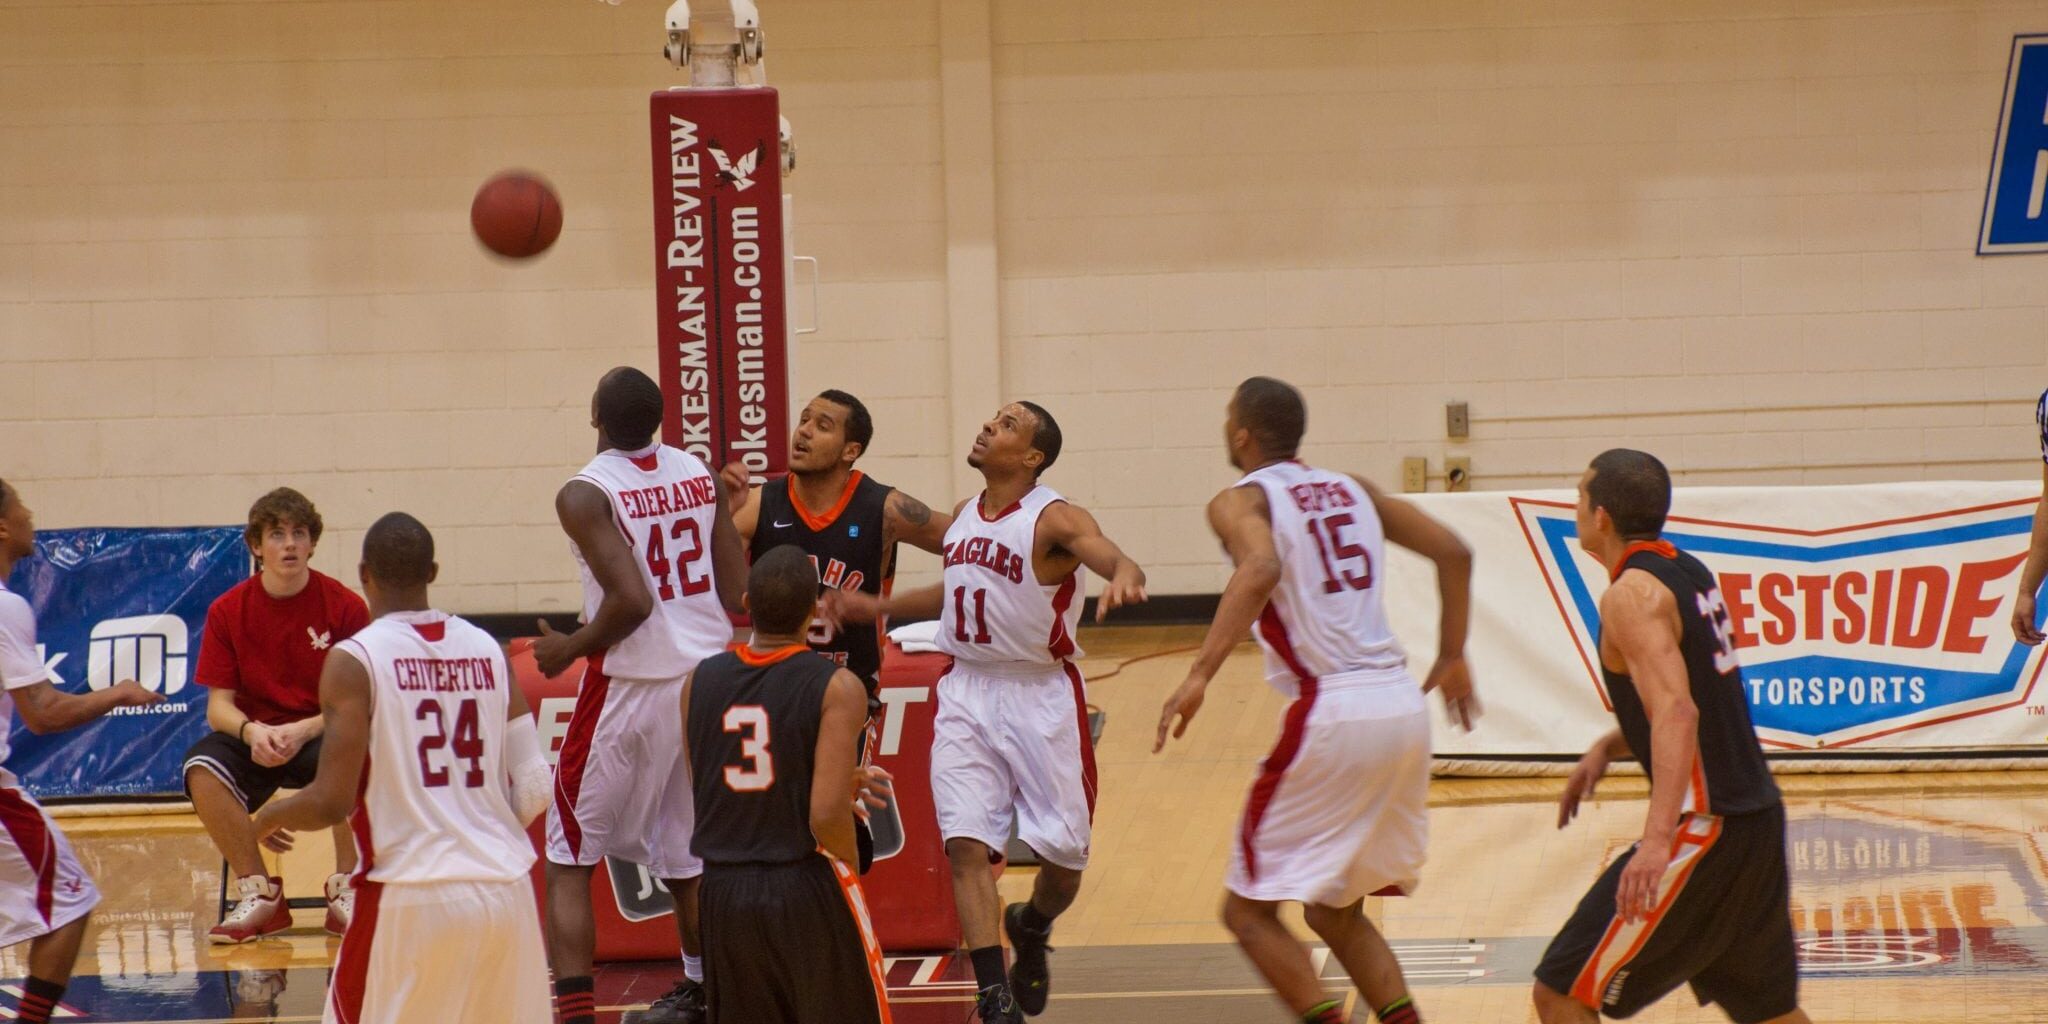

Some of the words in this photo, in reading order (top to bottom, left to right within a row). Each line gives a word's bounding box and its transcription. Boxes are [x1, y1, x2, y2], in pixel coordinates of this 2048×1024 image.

[618, 475, 717, 519] EDERAINE
[646, 517, 711, 602] 42
[1308, 512, 1372, 594] 15
[953, 585, 992, 644] 11
[393, 658, 496, 692] CHIVERTON
[416, 699, 484, 788] 24
[724, 705, 774, 791] 3
